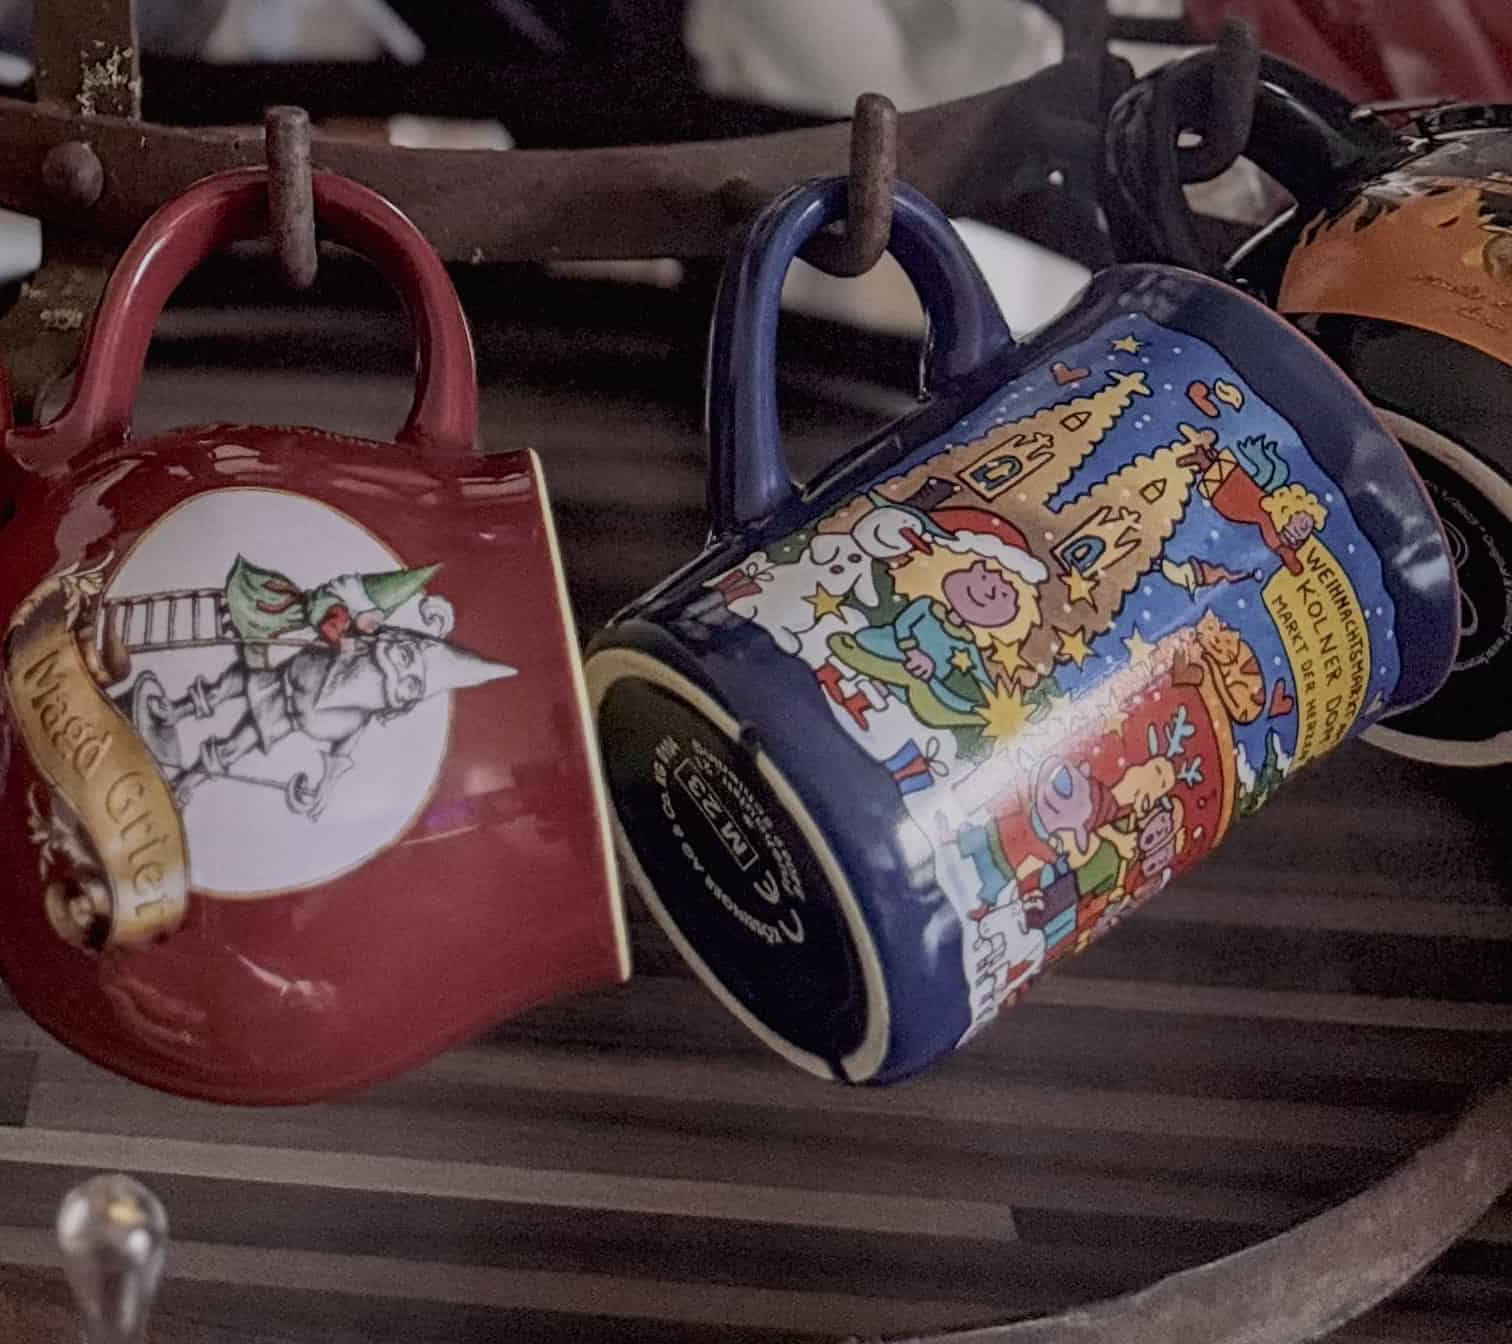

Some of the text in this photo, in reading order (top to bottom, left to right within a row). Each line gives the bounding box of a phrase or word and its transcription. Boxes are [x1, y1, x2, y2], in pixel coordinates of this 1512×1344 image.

[1271, 593, 1309, 655] MARKT
[1300, 658, 1317, 695] DER
[1305, 545, 1366, 718] WEIHNACHTSMARKT
[687, 774, 723, 820] 23
[719, 820, 748, 857] M
